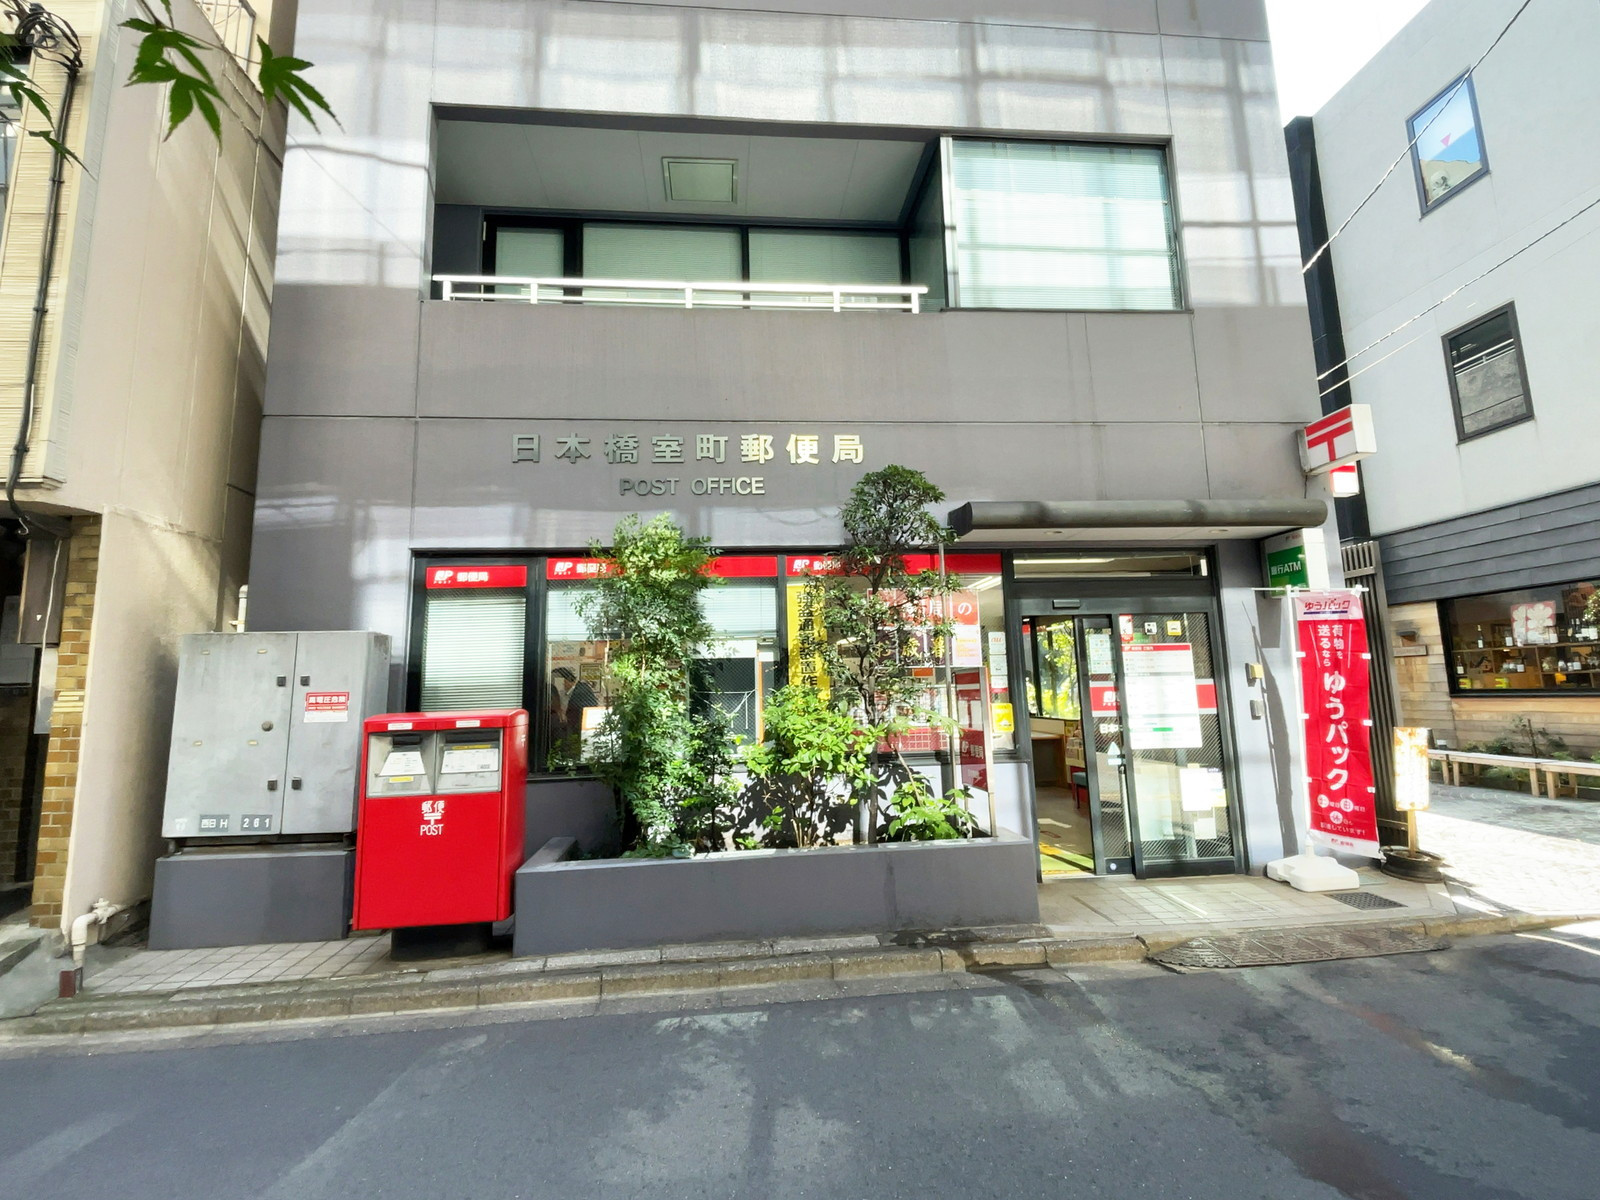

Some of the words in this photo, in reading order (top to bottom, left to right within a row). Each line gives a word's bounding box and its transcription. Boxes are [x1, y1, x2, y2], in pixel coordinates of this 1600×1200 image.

[511, 432, 865, 465] 日本橋室町郵便局
[619, 477, 680, 497] POST
[690, 476, 766, 496] OFFICE
[1304, 598, 1351, 611] ゆうパック
[1317, 624, 1332, 667] 送るなら
[1332, 624, 1345, 659] 荷物を
[1323, 670, 1350, 791] ゆうパック
[421, 800, 445, 814] 郵便
[243, 817, 270, 828] 261
[420, 824, 444, 836] POST
